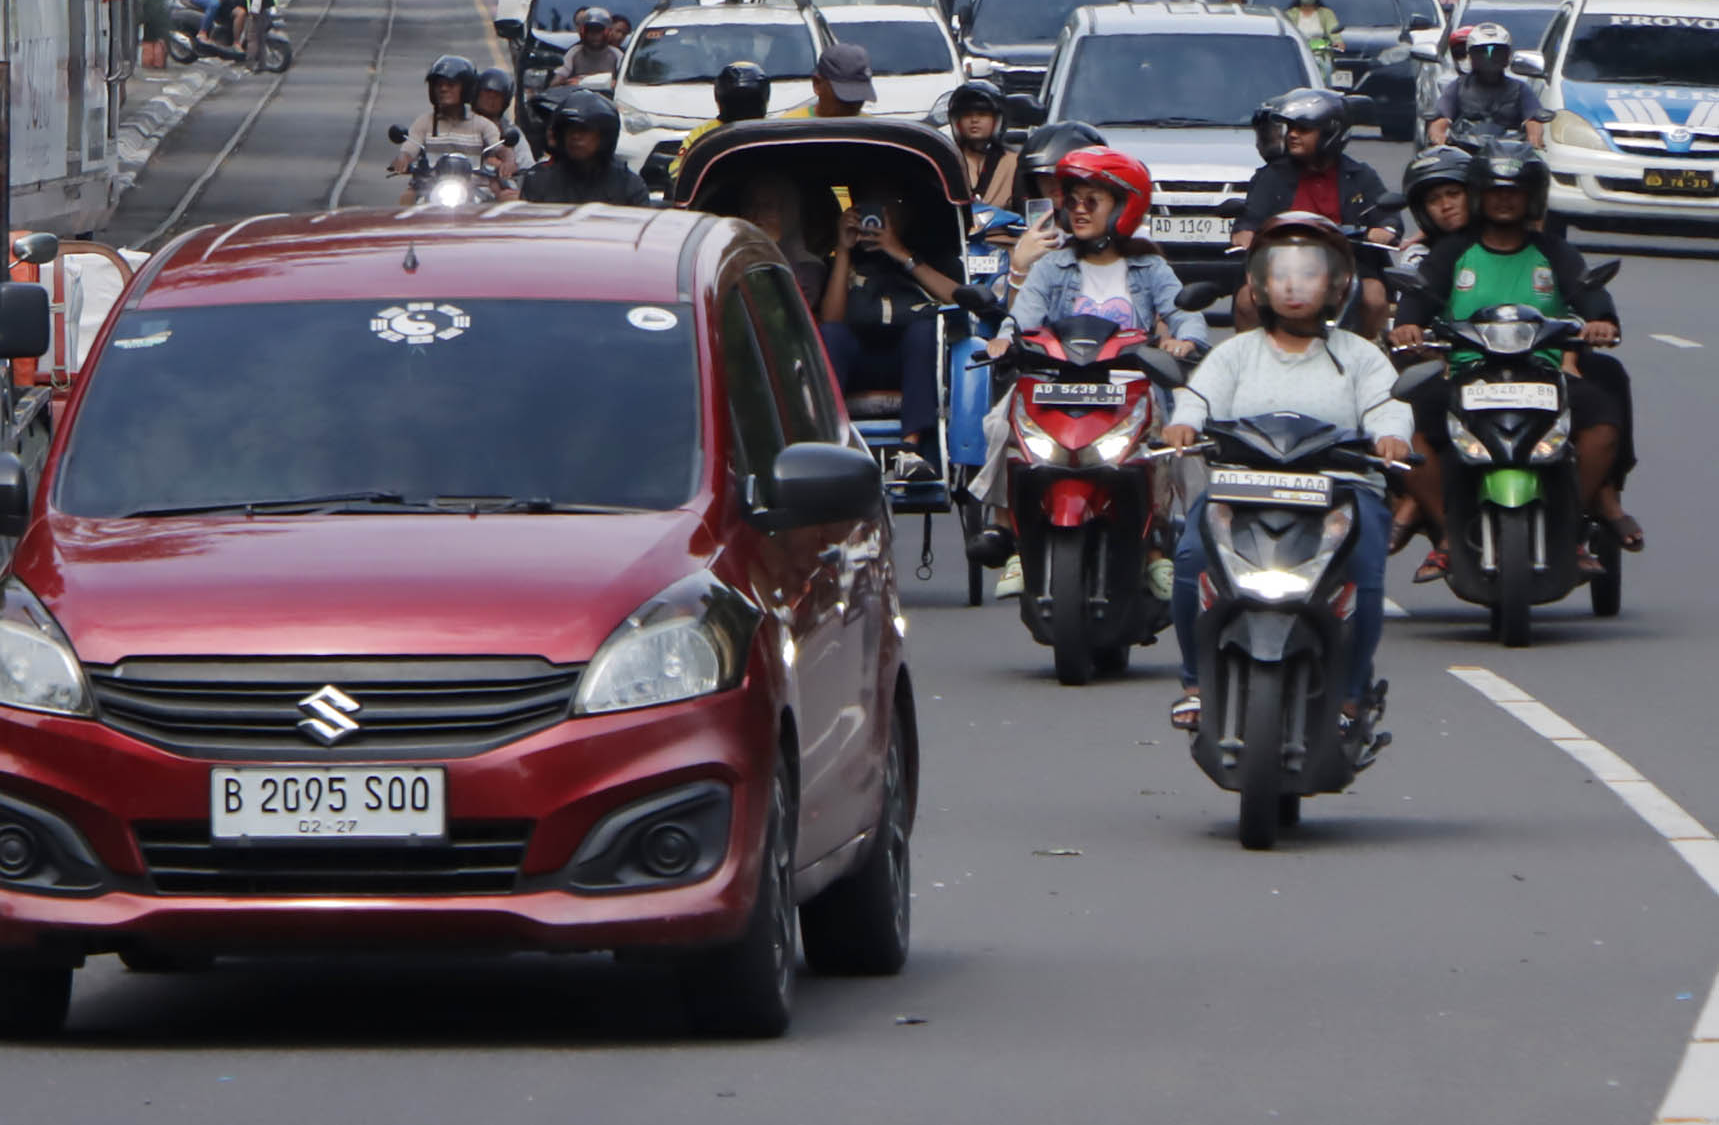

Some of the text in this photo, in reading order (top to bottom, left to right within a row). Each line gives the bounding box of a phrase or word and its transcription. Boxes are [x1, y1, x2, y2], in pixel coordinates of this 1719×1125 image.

[1609, 15, 1719, 29] PROVO
[1155, 219, 1171, 233] AD
[1034, 384, 1053, 394] AD
[1218, 473, 1238, 484] AD
[1294, 477, 1327, 491] AAA
[224, 777, 243, 814] B
[261, 777, 347, 813] 2095
